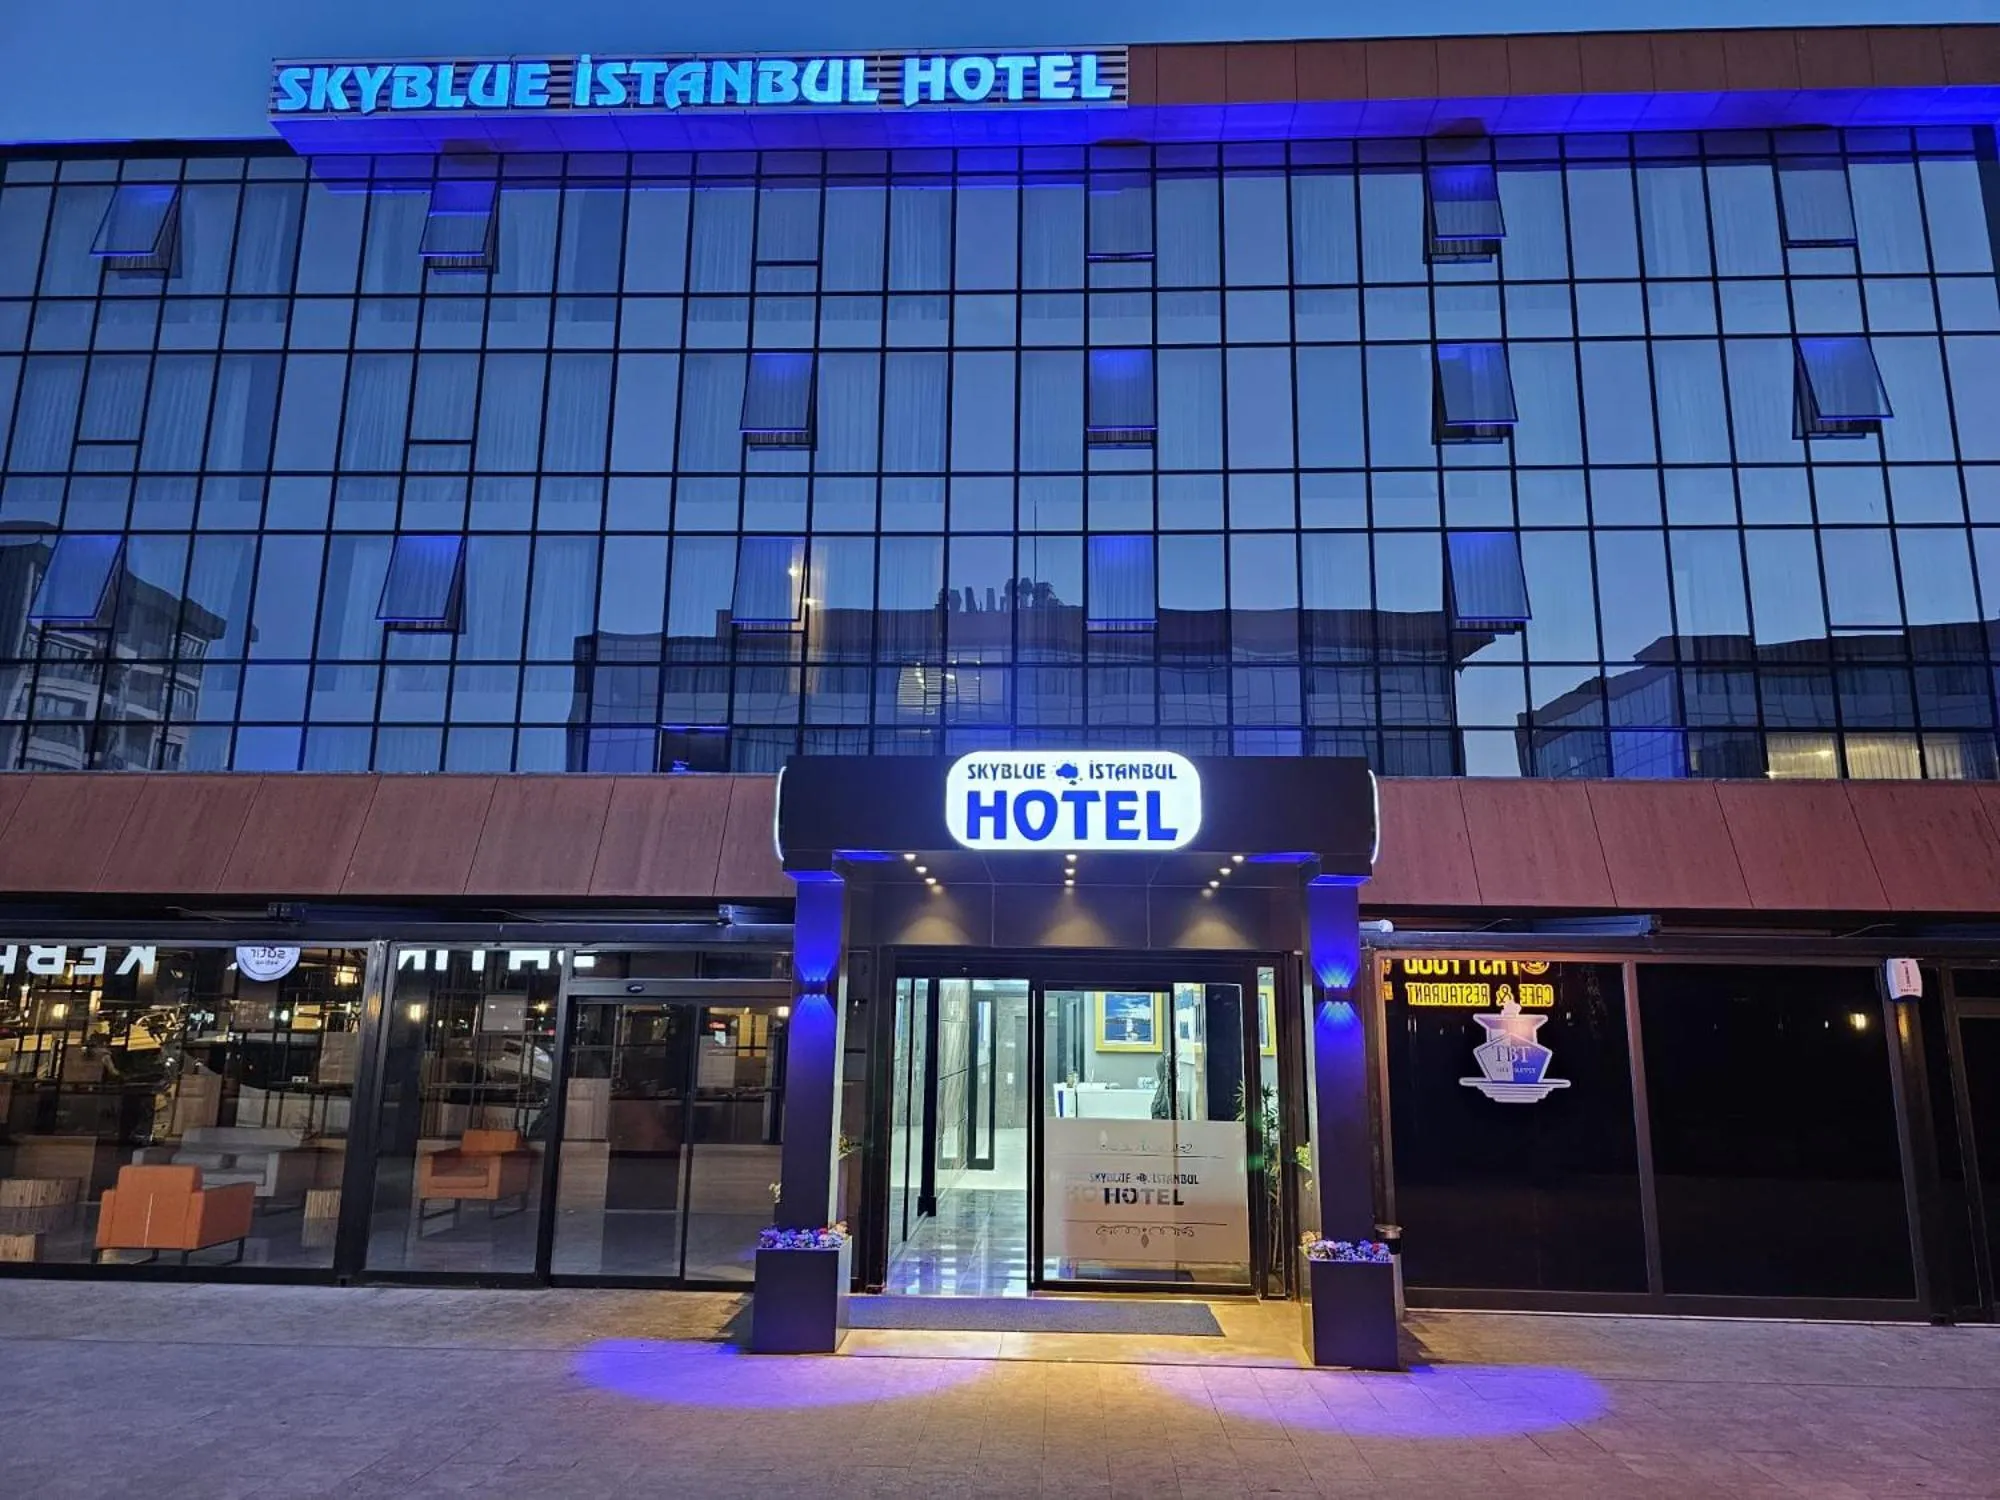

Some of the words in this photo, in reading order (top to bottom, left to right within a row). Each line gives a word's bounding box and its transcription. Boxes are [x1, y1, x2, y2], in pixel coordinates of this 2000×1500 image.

[277, 63, 551, 114] SKYBLUE
[574, 54, 880, 113] İSTANBUL
[904, 54, 1113, 107] HOTEL
[967, 763, 1046, 781] SKYBLUE
[1089, 760, 1177, 781] İSTANBUL
[966, 789, 1178, 841] HOTEL
[1104, 1187, 1184, 1206] HOTEL
